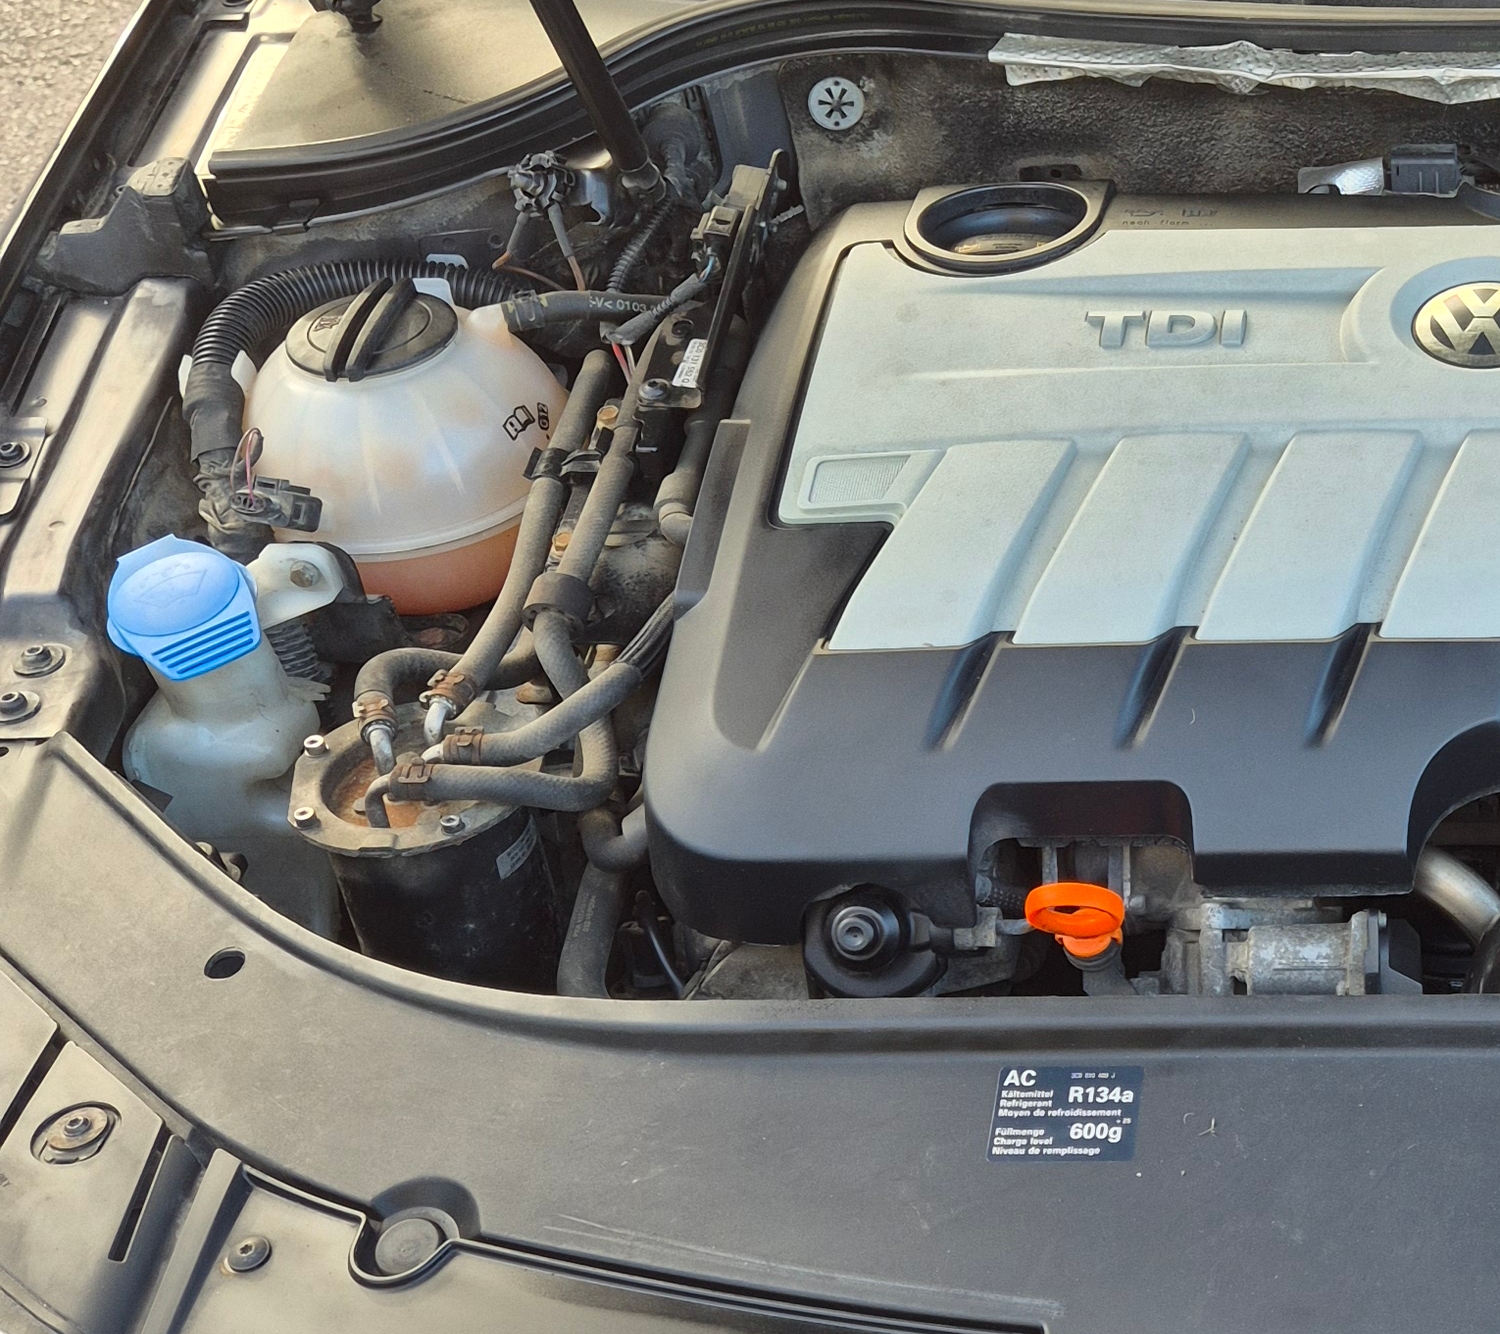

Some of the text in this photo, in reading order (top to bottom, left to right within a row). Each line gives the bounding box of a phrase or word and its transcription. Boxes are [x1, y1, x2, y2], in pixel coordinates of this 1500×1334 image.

[616, 299, 647, 313] 0103
[1086, 309, 1247, 347] TDI
[1003, 1069, 1037, 1087] AC
[1001, 1090, 1054, 1098] Kältemittel
[1068, 1086, 1134, 1103] R134a
[999, 1099, 1053, 1108] Refrigerant
[998, 1109, 1030, 1118] Moyen
[1047, 1108, 1122, 1116] refroidissement
[994, 1128, 1044, 1137] Füllmenge
[1069, 1122, 1123, 1143] 600g
[993, 1137, 1053, 1146] Charge level
[992, 1146, 1101, 1156] Niveau de remplissage
